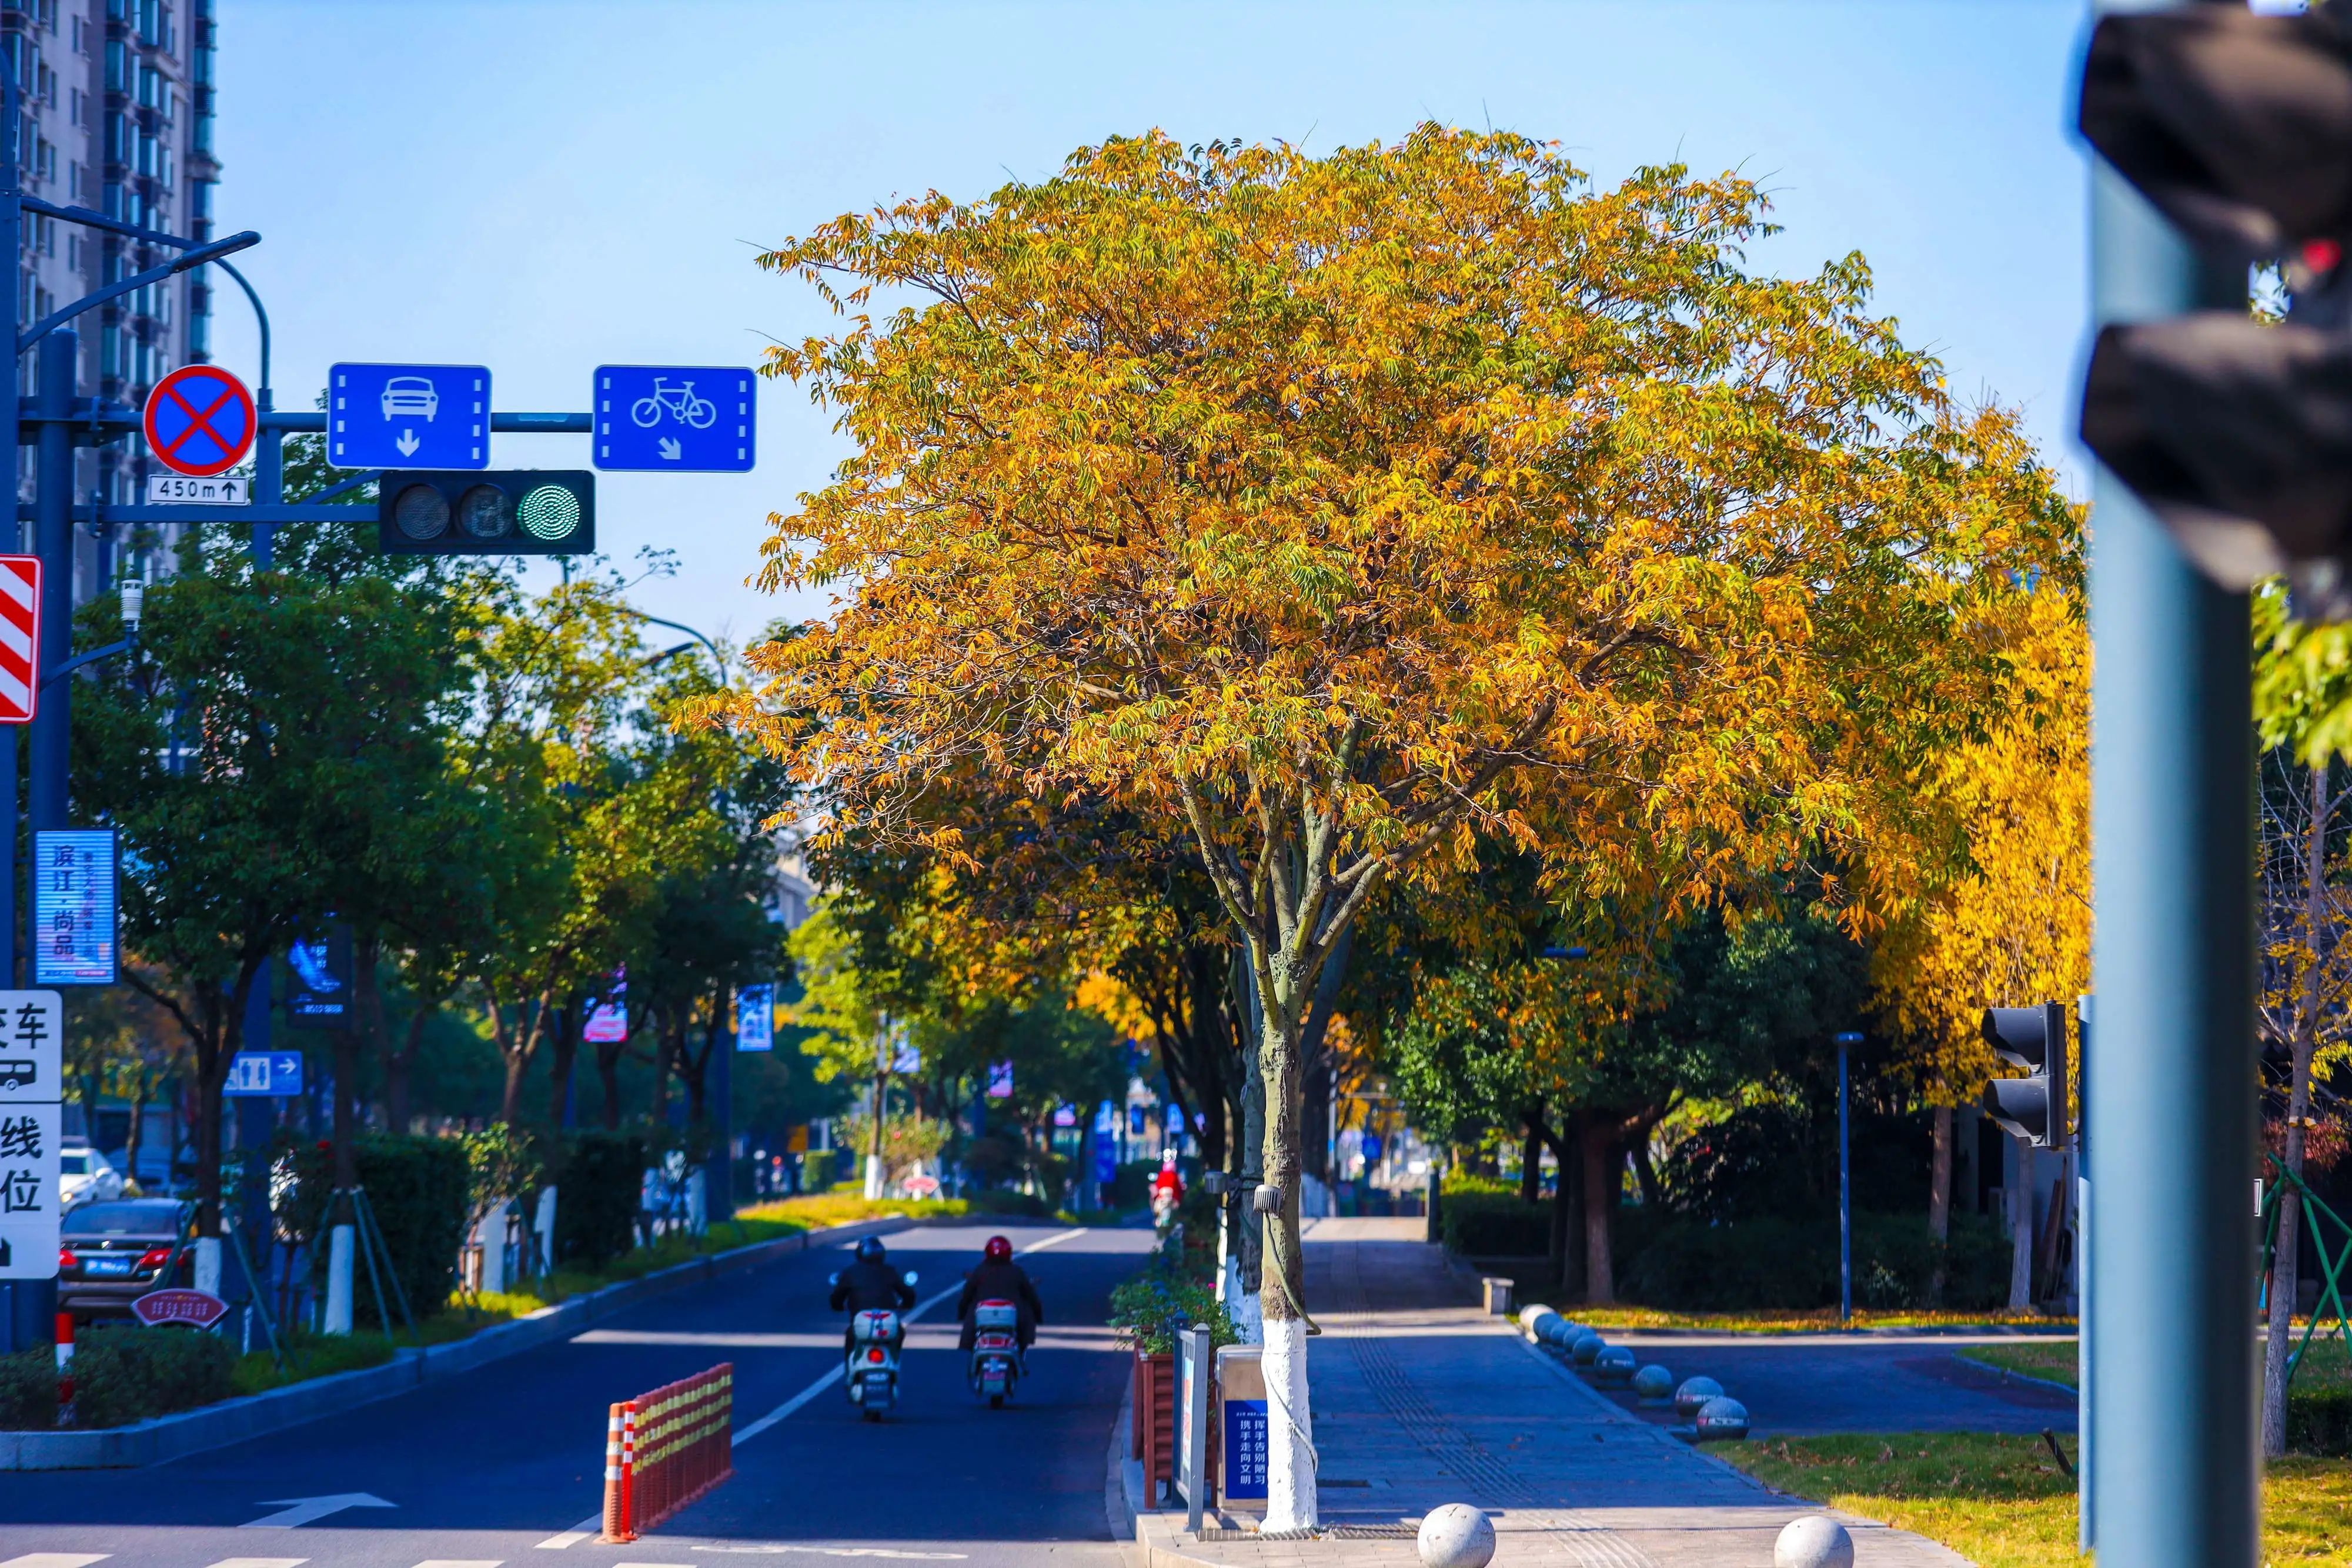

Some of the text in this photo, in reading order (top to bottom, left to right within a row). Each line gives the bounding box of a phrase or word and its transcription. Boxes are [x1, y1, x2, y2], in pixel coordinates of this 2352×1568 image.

[160, 480, 215, 497] 450m
[1, 1116, 44, 1159] 线
[1, 1169, 42, 1213] 位
